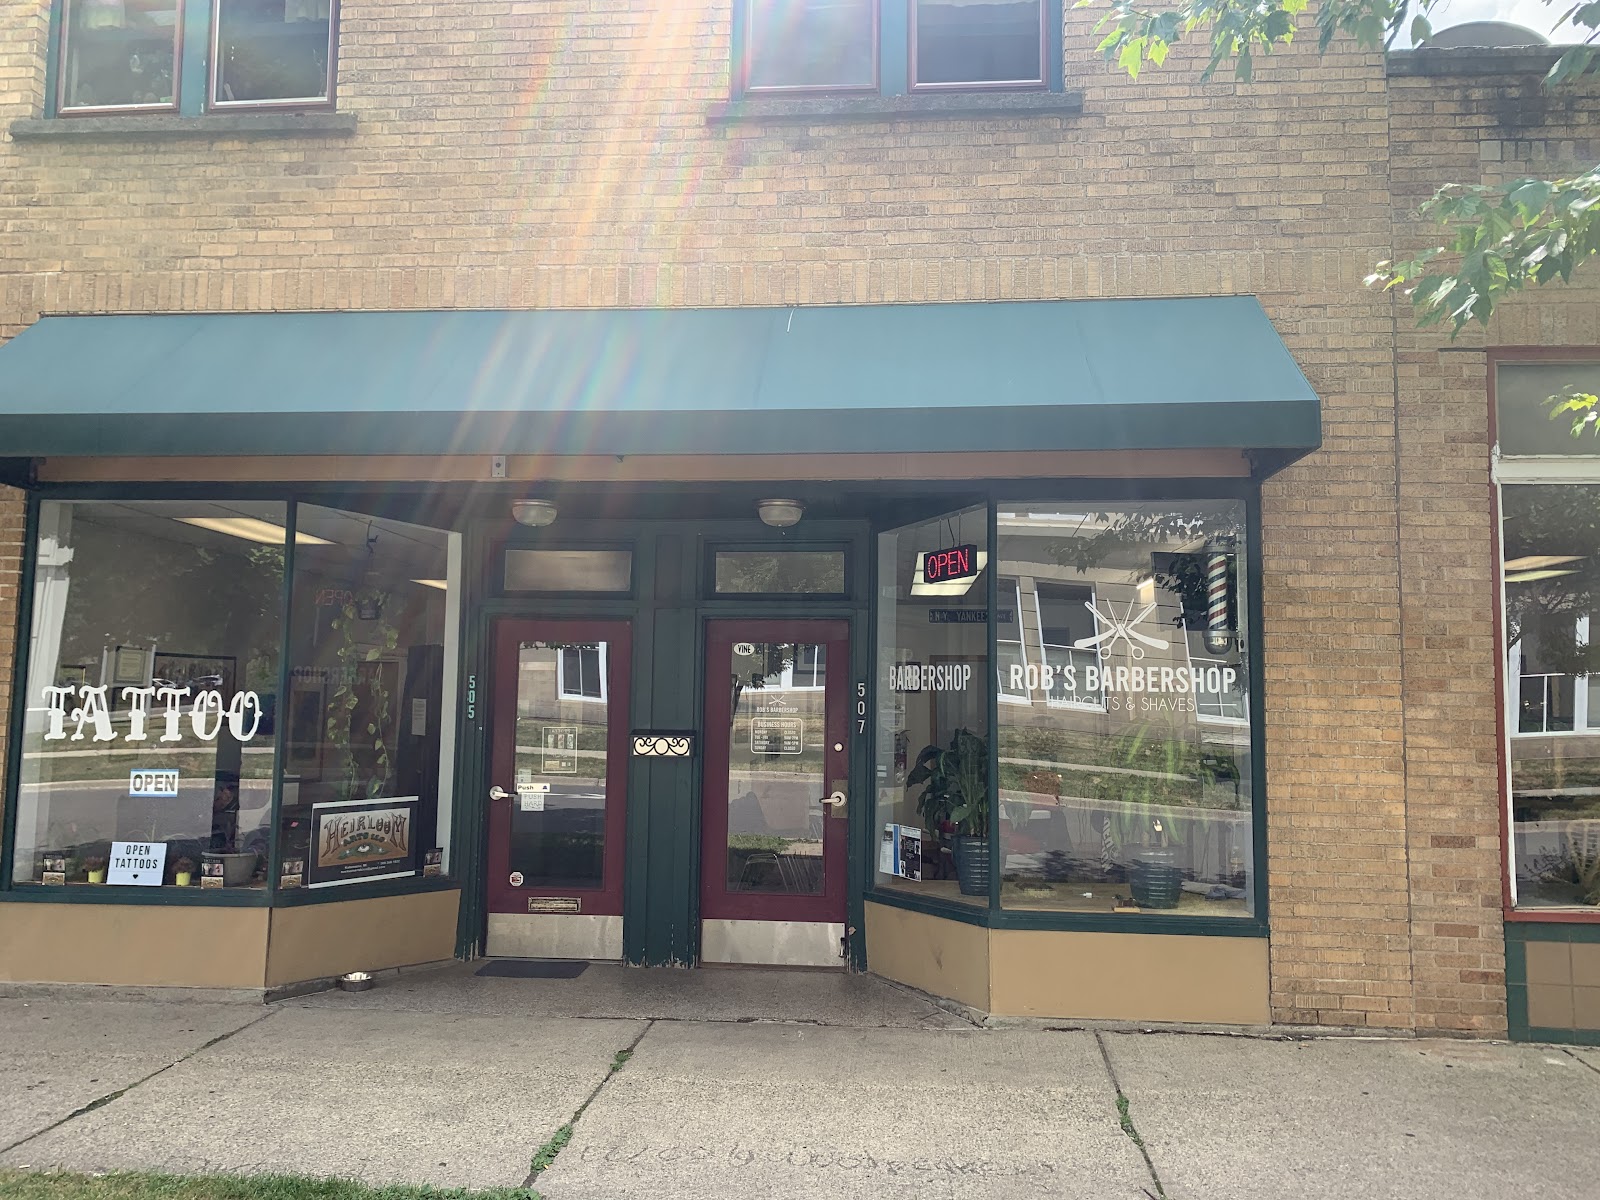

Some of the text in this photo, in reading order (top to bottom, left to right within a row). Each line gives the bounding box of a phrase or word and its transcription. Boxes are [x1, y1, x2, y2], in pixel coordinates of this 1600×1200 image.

[928, 549, 968, 578] OPEN
[956, 612, 987, 622] YANKEE
[738, 645, 751, 653] VINE
[889, 664, 971, 691] BARBERSHOP
[1010, 664, 1236, 694] ROB'S BARBERSHOP
[468, 675, 476, 719] 505
[857, 682, 866, 734] 507
[1050, 695, 1195, 712] HAIRCUTS & SHAVES
[41, 685, 263, 742] TATTOO
[133, 775, 175, 792] OPEN
[321, 811, 407, 858] HEIRLOOM
[115, 857, 158, 869] TATTOOS
[126, 844, 151, 856] OPEN
